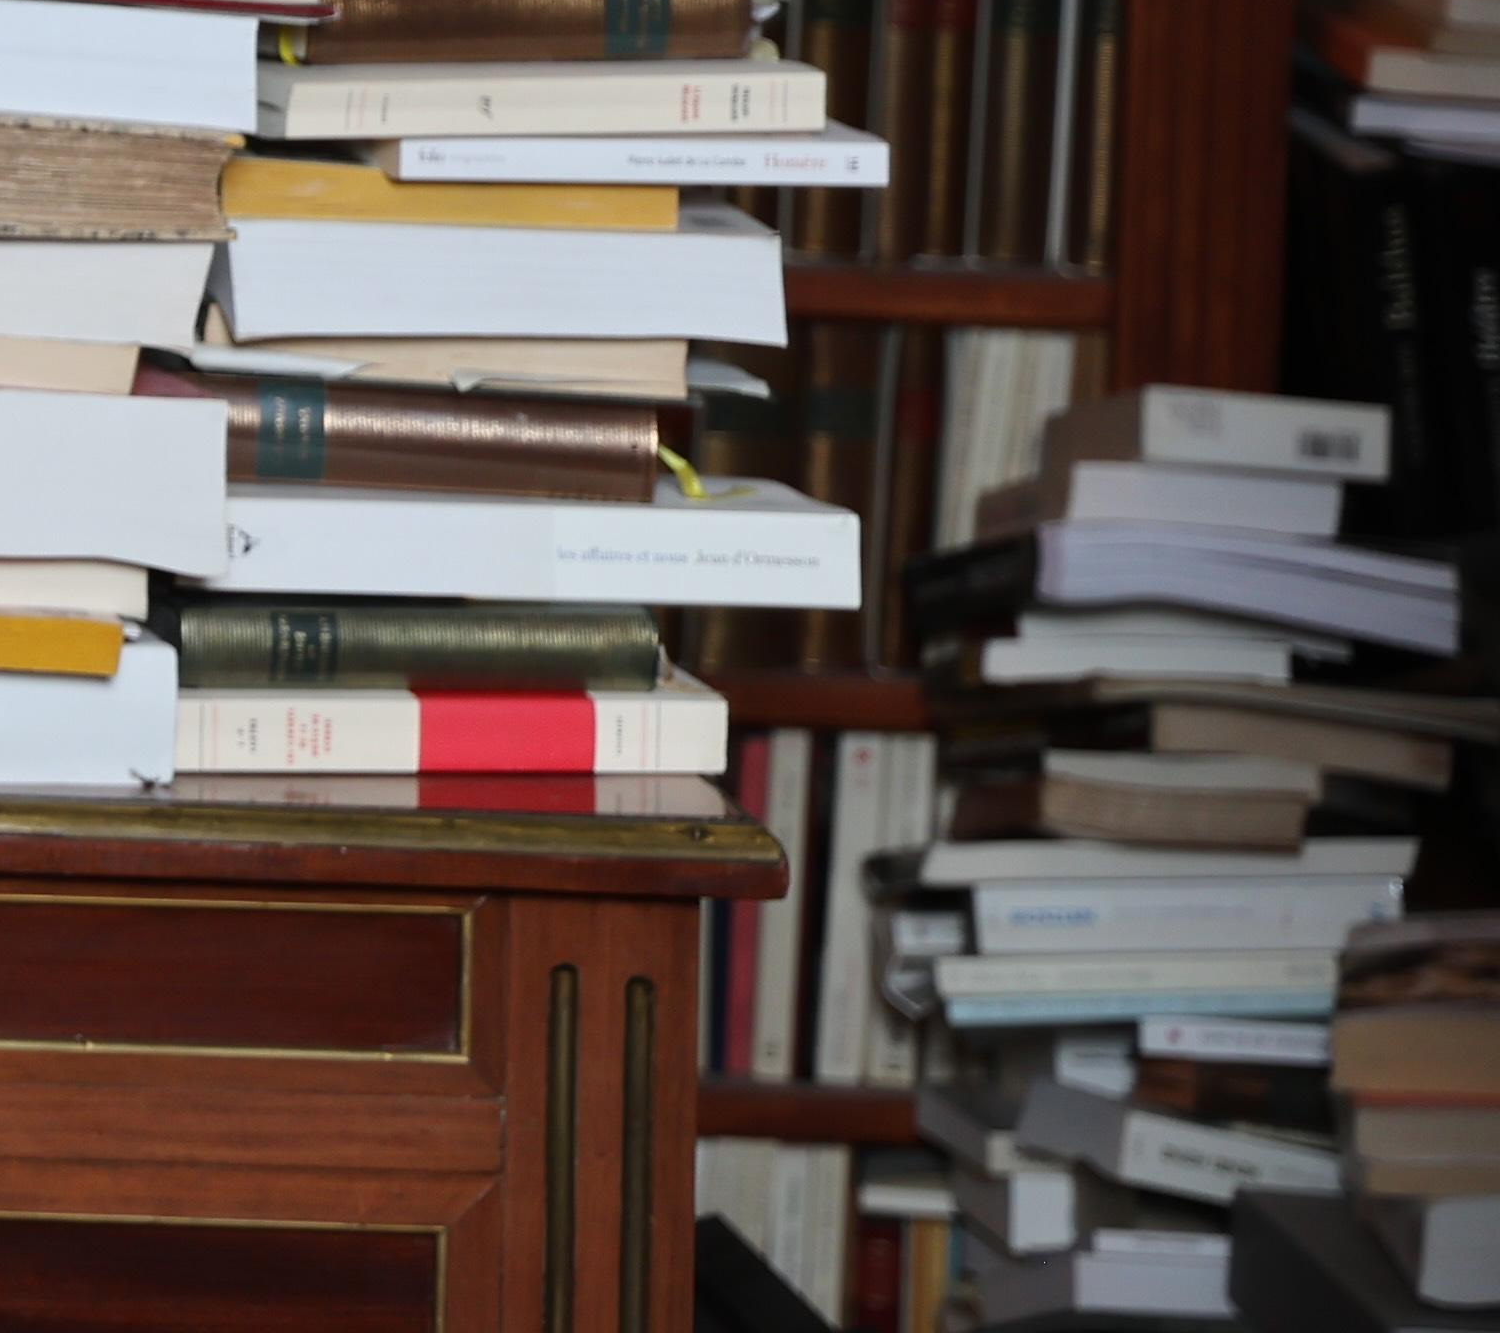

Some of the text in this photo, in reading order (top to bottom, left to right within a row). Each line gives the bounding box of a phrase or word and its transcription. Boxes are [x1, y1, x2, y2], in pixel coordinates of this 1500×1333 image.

[580, 546, 633, 561] affaires
[695, 547, 727, 564] Jean
[730, 548, 821, 566] d'Ormesson
